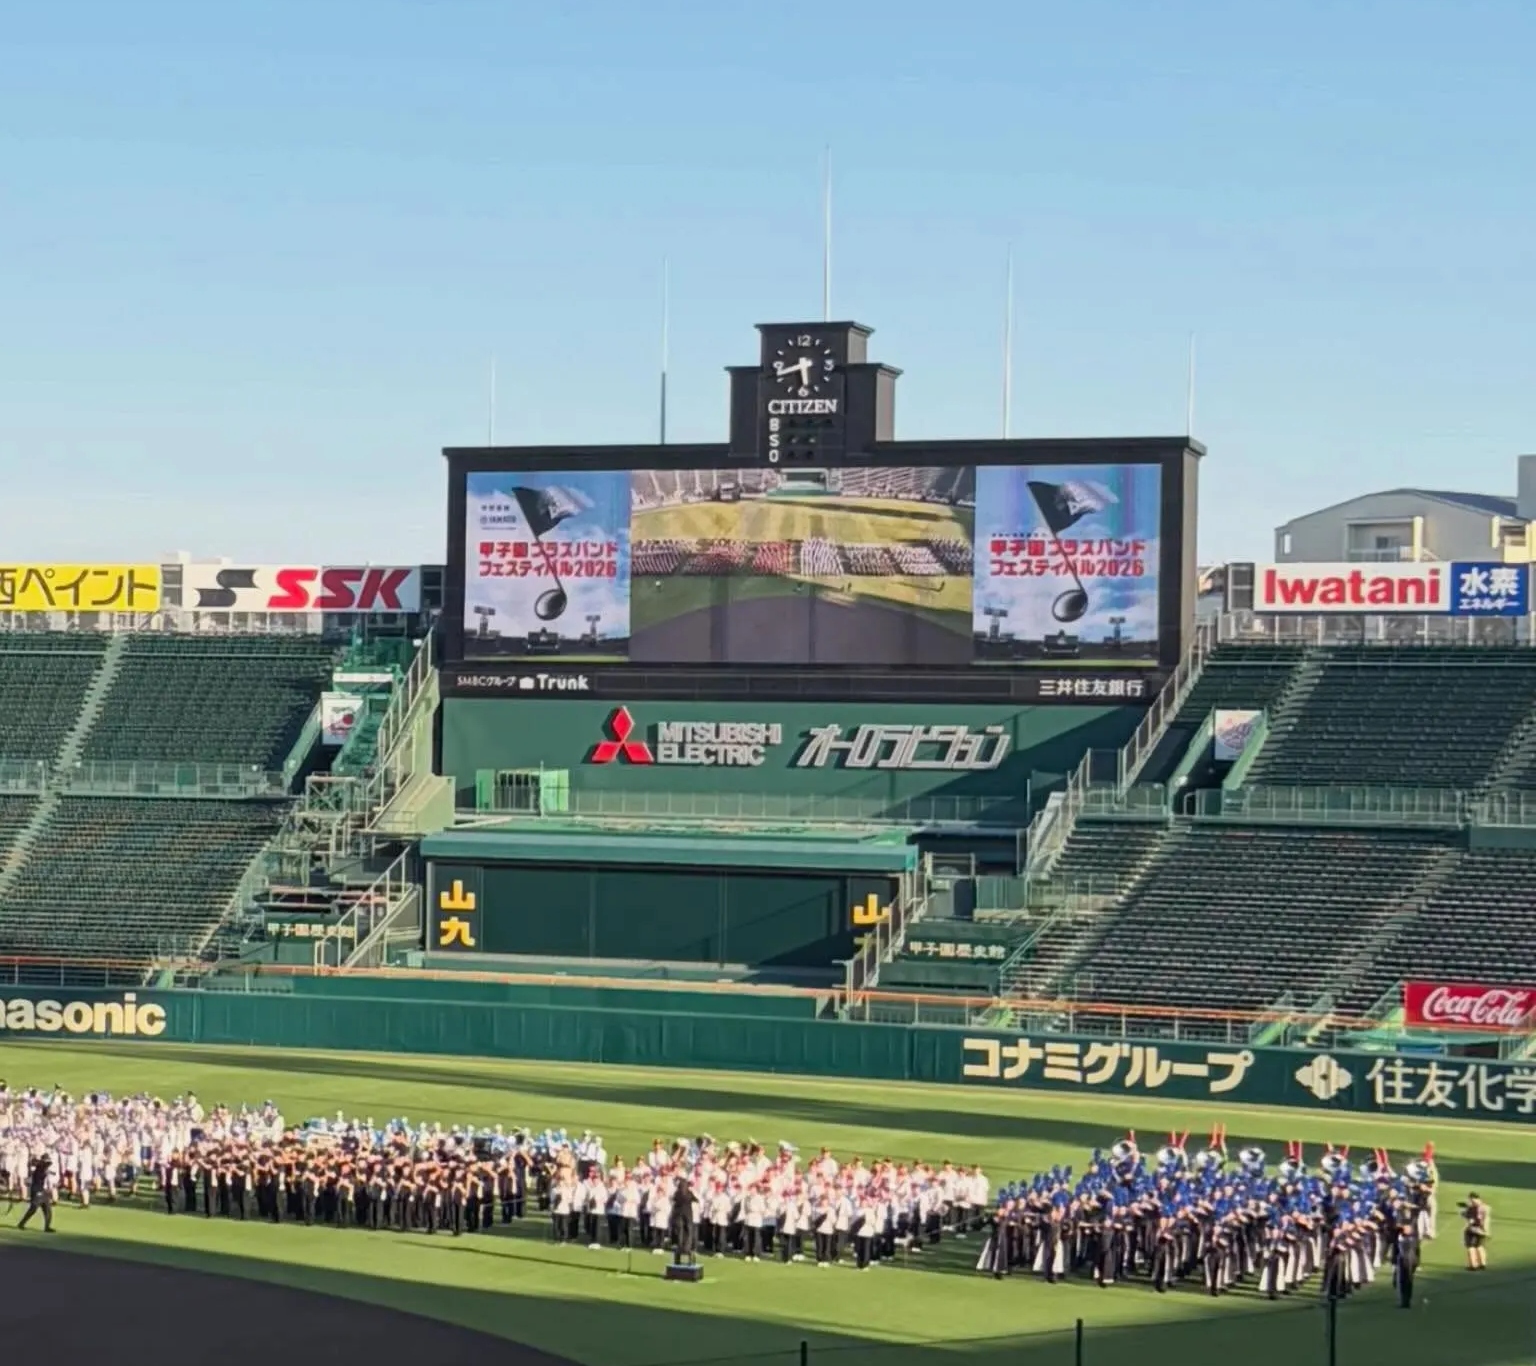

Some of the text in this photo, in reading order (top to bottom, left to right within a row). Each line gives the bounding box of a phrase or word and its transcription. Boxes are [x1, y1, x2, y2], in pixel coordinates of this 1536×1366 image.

[797, 335, 811, 347] 12
[824, 360, 834, 371] 3
[798, 385, 809, 397] 6
[768, 399, 838, 414] CITIZEN
[769, 418, 780, 431] B
[769, 434, 780, 447] S
[267, 569, 410, 608] SSK
[1265, 569, 1441, 605] Iwatani
[1459, 567, 1518, 595] 水素
[1459, 598, 1519, 610] エネルギー
[536, 673, 589, 690] Trunk
[1039, 678, 1144, 697] 三井住友銀行
[658, 721, 782, 744] MITSUBISHI
[658, 742, 765, 766] ELECTRIC
[440, 880, 476, 946] 山九
[963, 1038, 1254, 1092] コナミグループ
